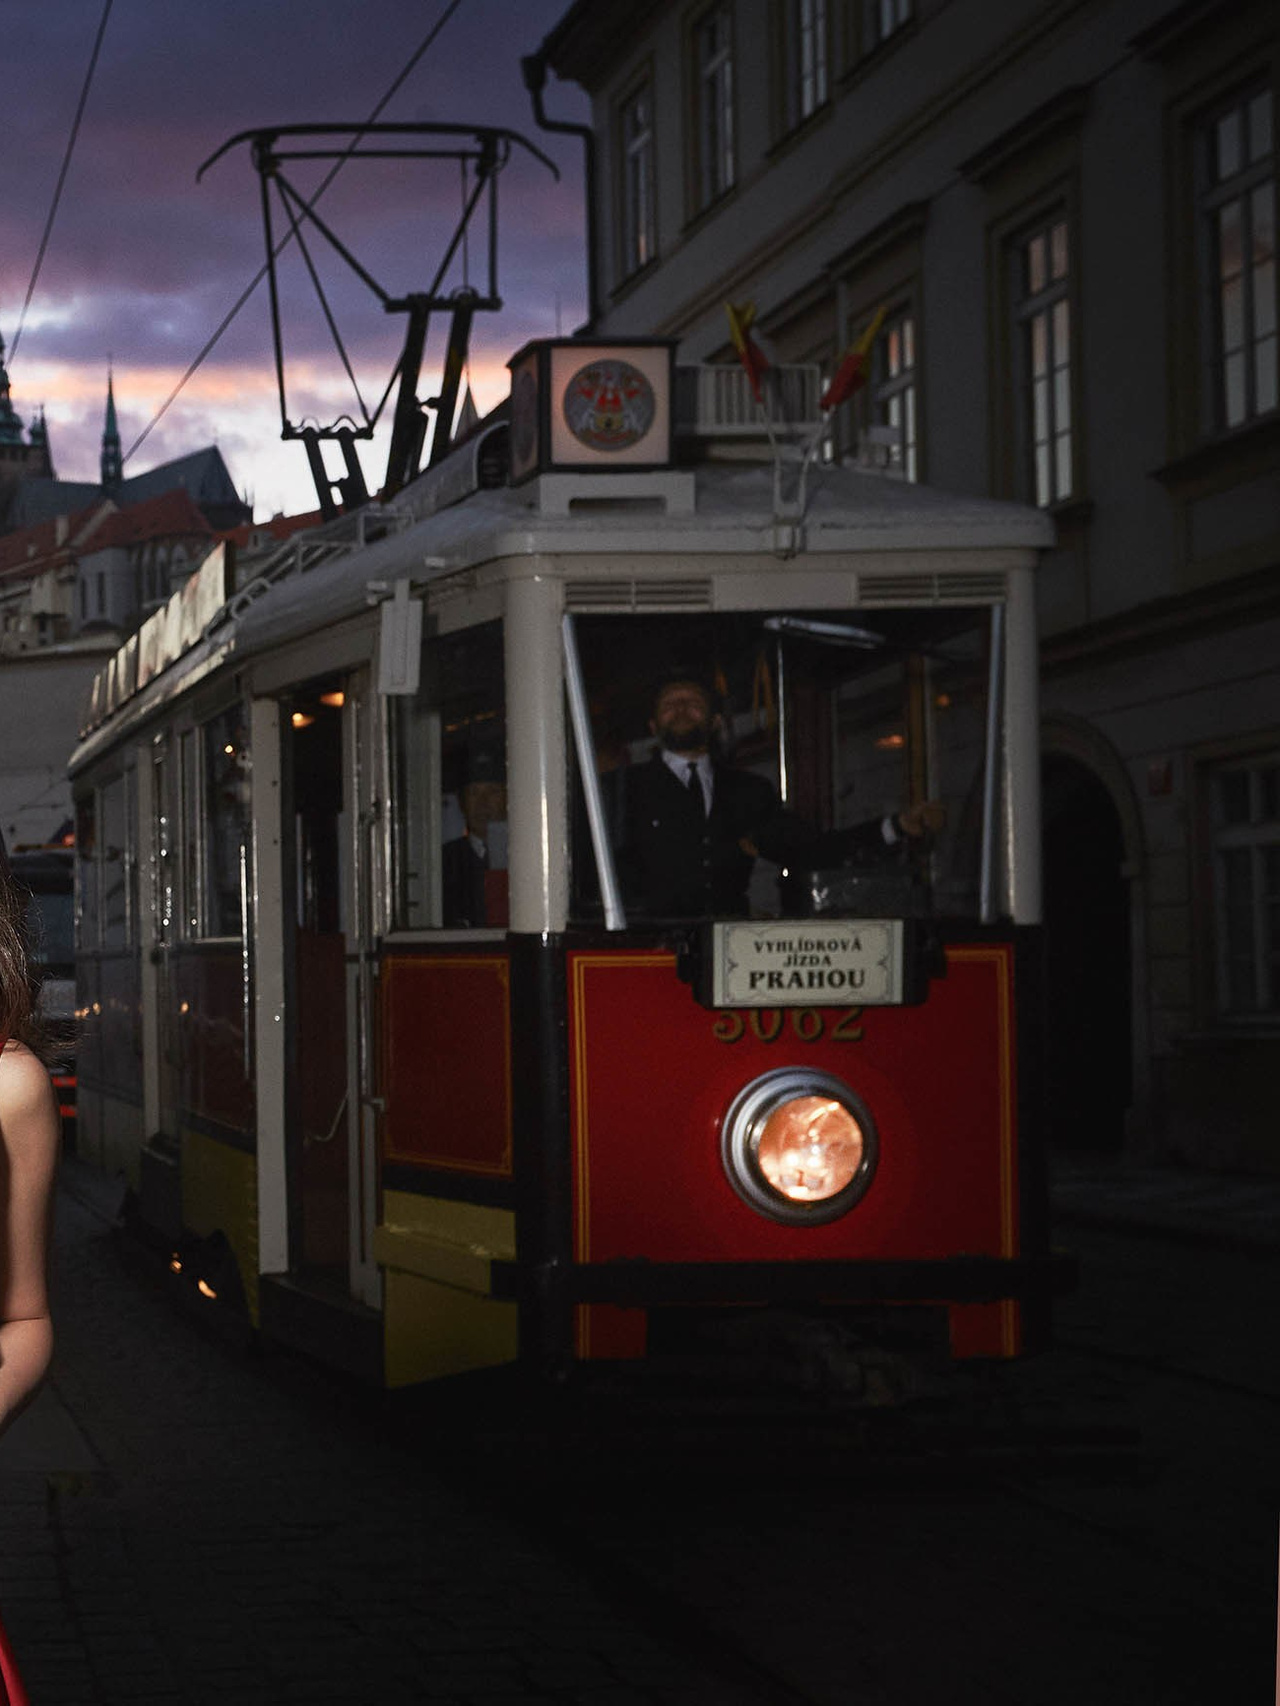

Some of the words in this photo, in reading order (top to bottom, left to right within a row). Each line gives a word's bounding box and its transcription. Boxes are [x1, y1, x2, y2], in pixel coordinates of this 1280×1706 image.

[754, 937, 862, 954] VYHLÍDKOVÁ
[783, 954, 832, 967] JÍZDA
[749, 969, 866, 989] PRAHOU
